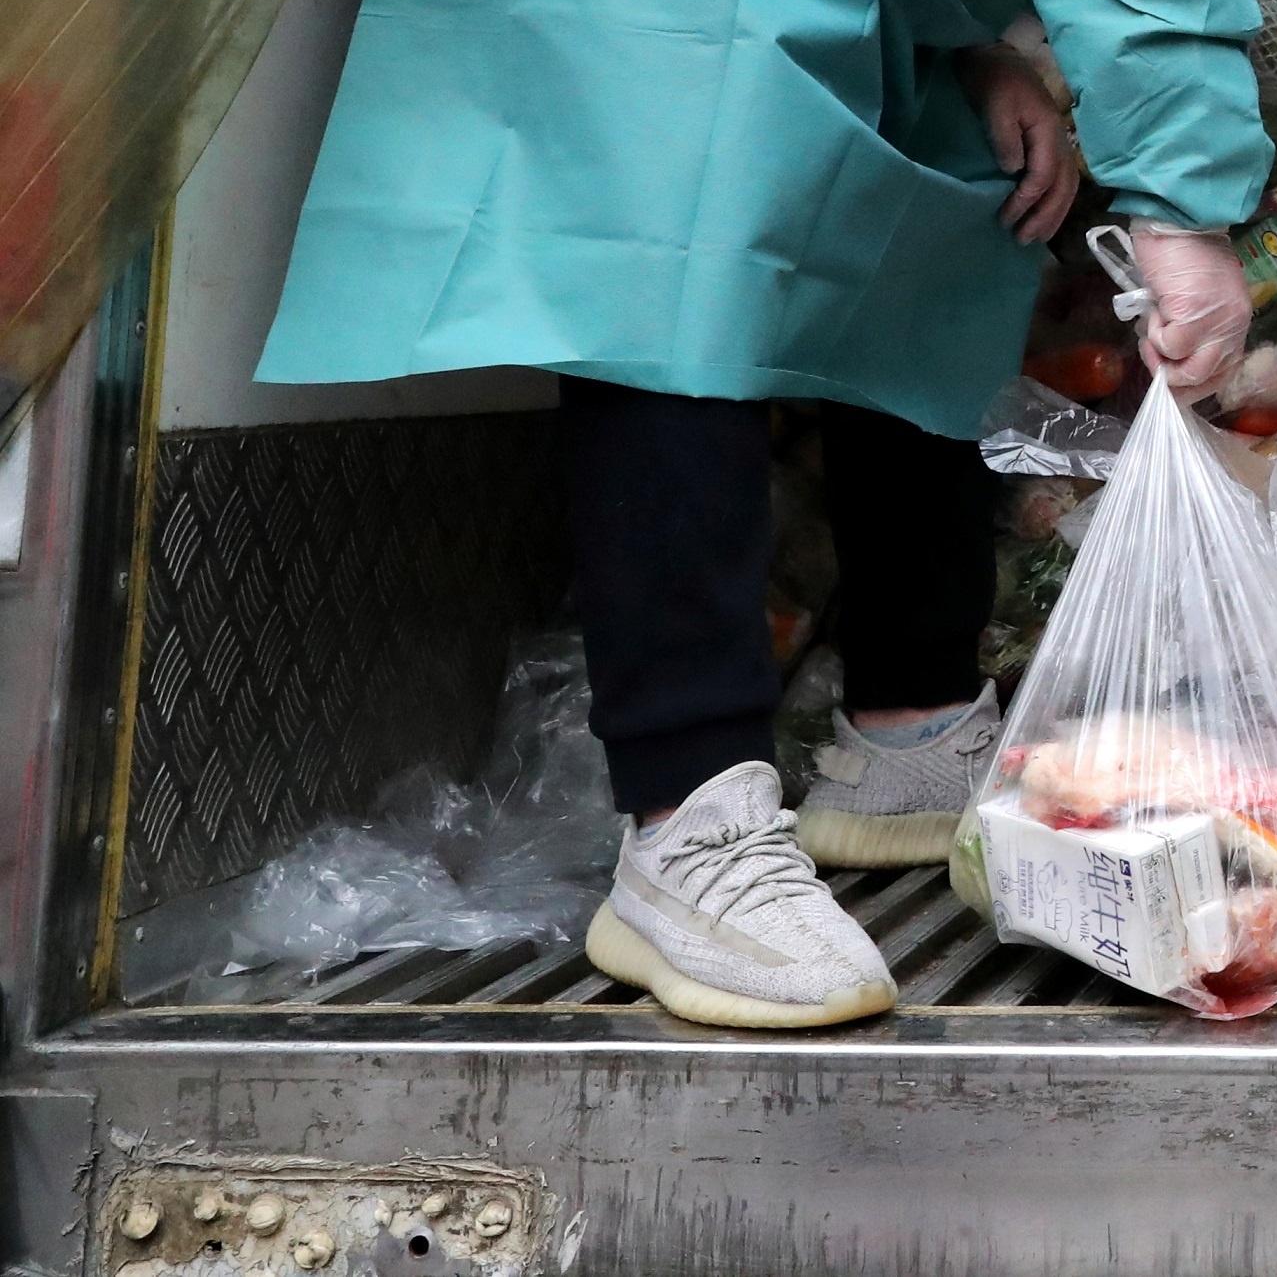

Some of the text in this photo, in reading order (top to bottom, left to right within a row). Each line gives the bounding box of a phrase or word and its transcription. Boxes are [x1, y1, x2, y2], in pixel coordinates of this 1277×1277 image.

[1077, 870, 1090, 943] Pure Milk
[1083, 846, 1132, 980] 纯牛奶
